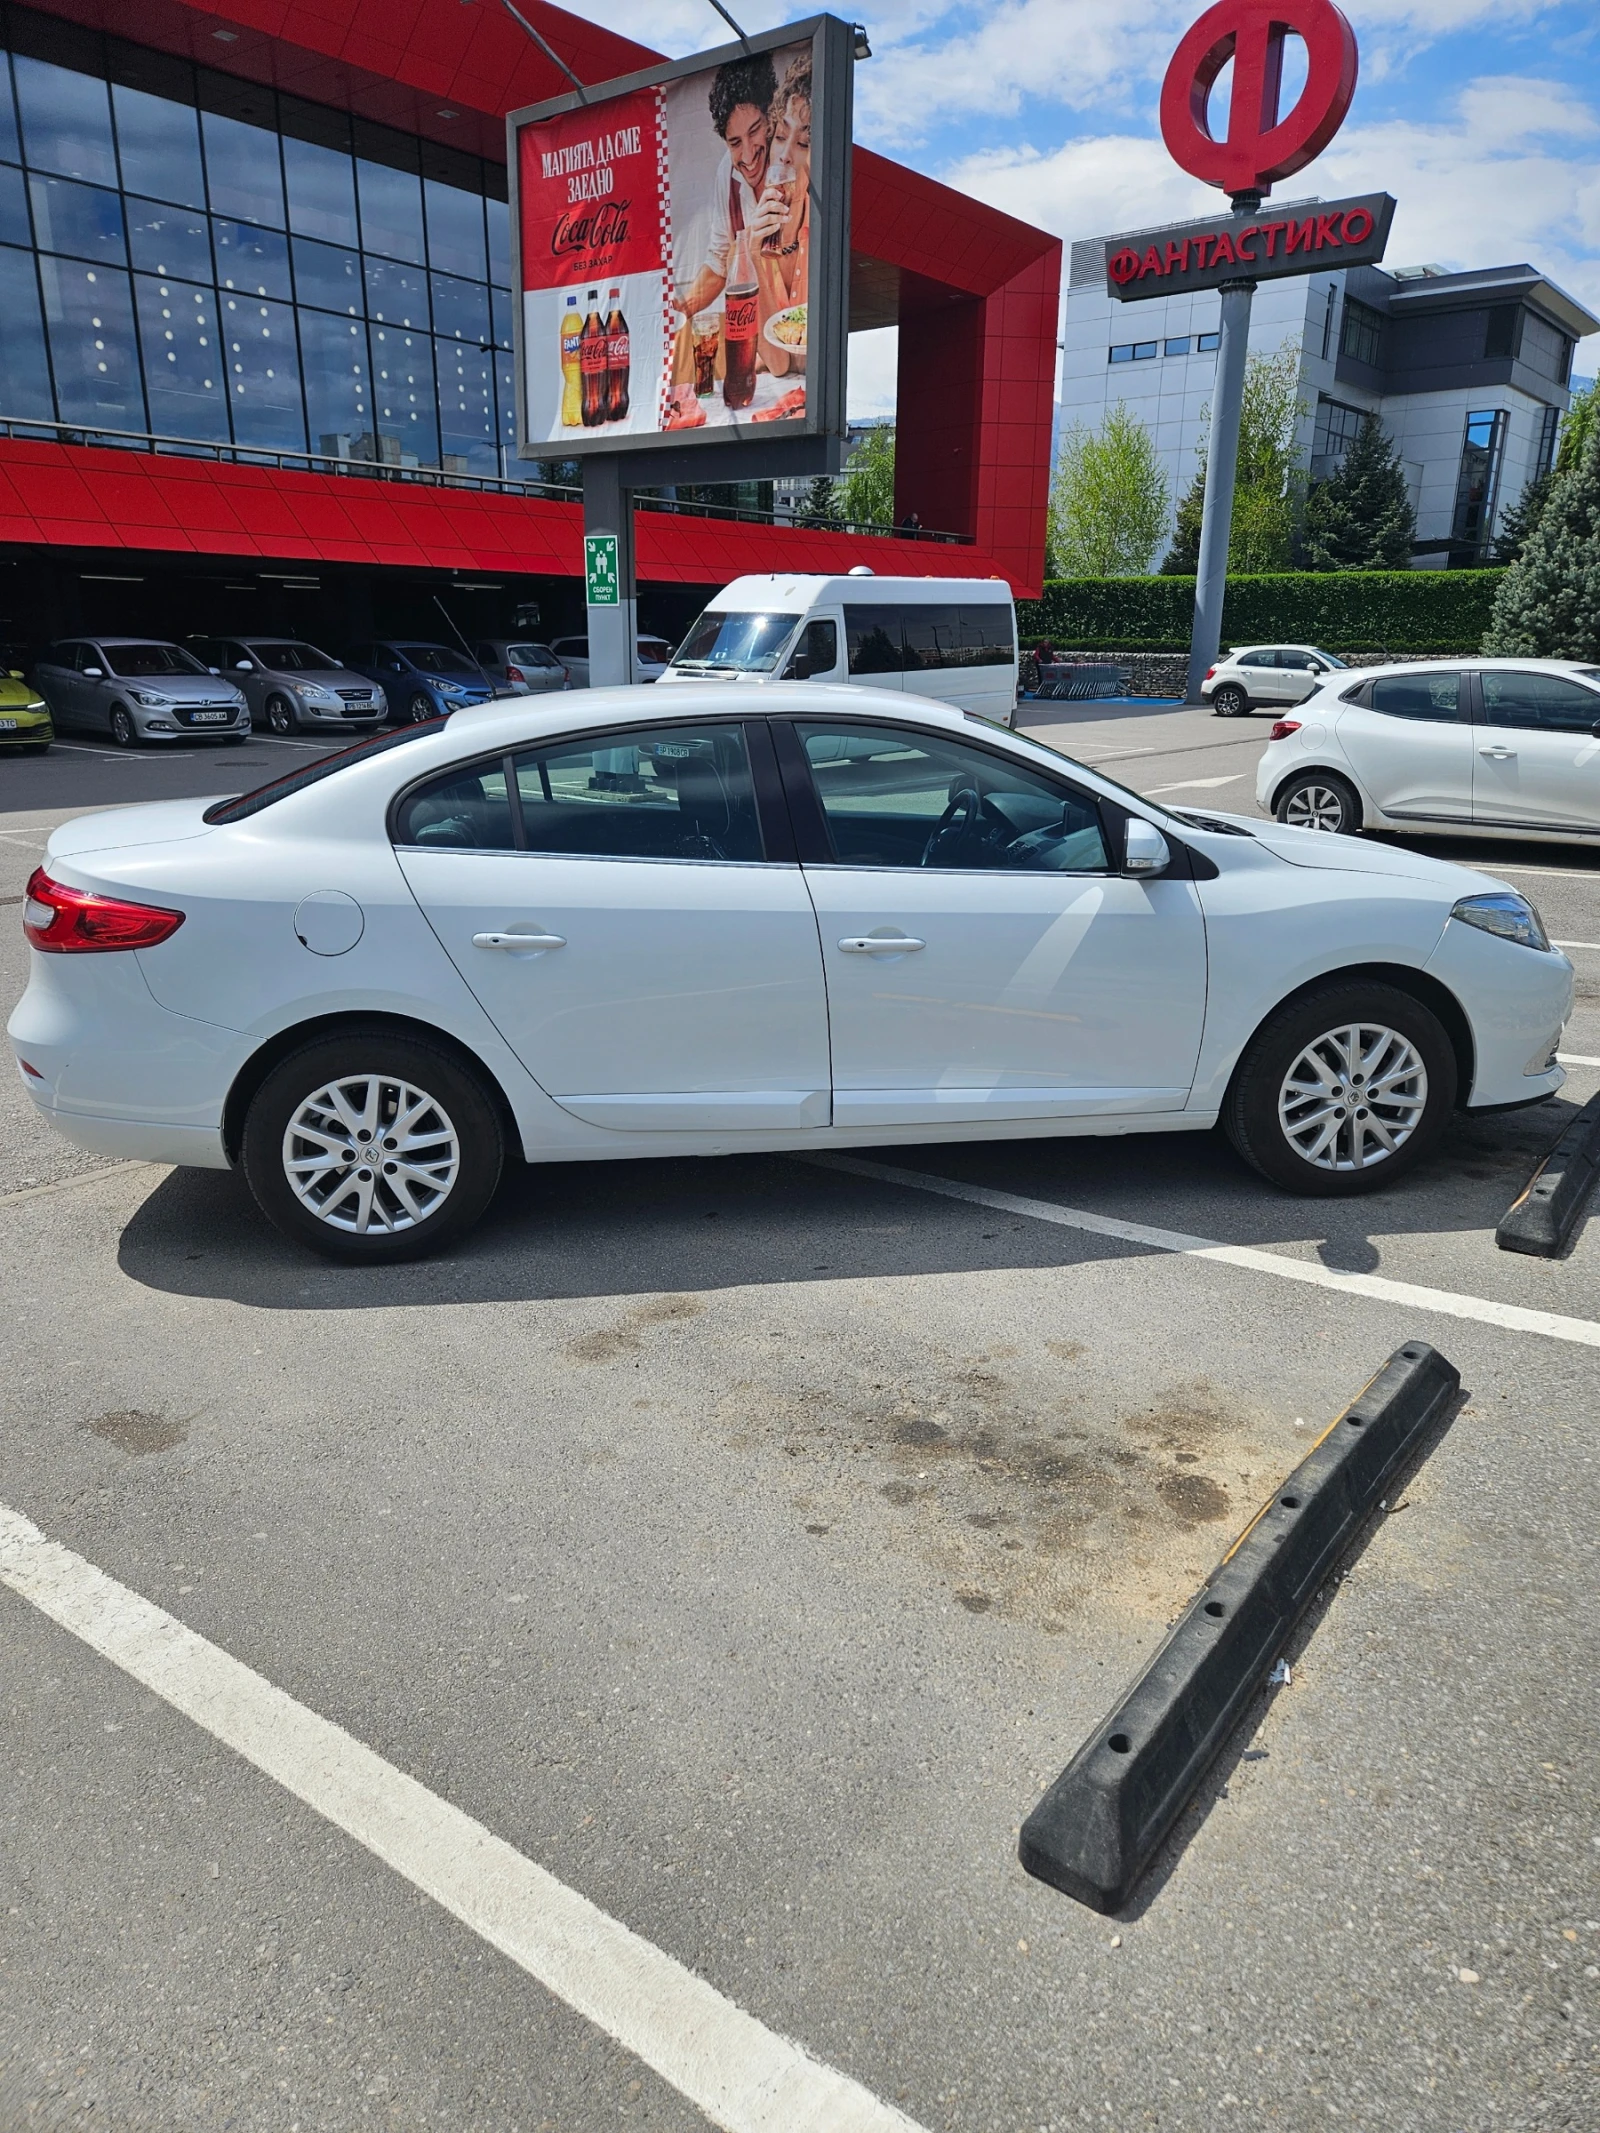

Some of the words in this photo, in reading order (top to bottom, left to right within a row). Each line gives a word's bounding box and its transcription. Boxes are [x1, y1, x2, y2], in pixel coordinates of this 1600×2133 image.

[541, 140, 595, 179] МАГИЯТА
[595, 134, 615, 169] ДА
[614, 126, 642, 158] СМЕ
[567, 167, 614, 203] ЗАЕДНО
[551, 199, 633, 256] Coca-Cola
[1108, 207, 1373, 285] ФАНТАСТИКО
[573, 260, 587, 271] БЕЗ
[588, 255, 613, 269] ЗАХАР
[564, 336, 581, 351] FANT
